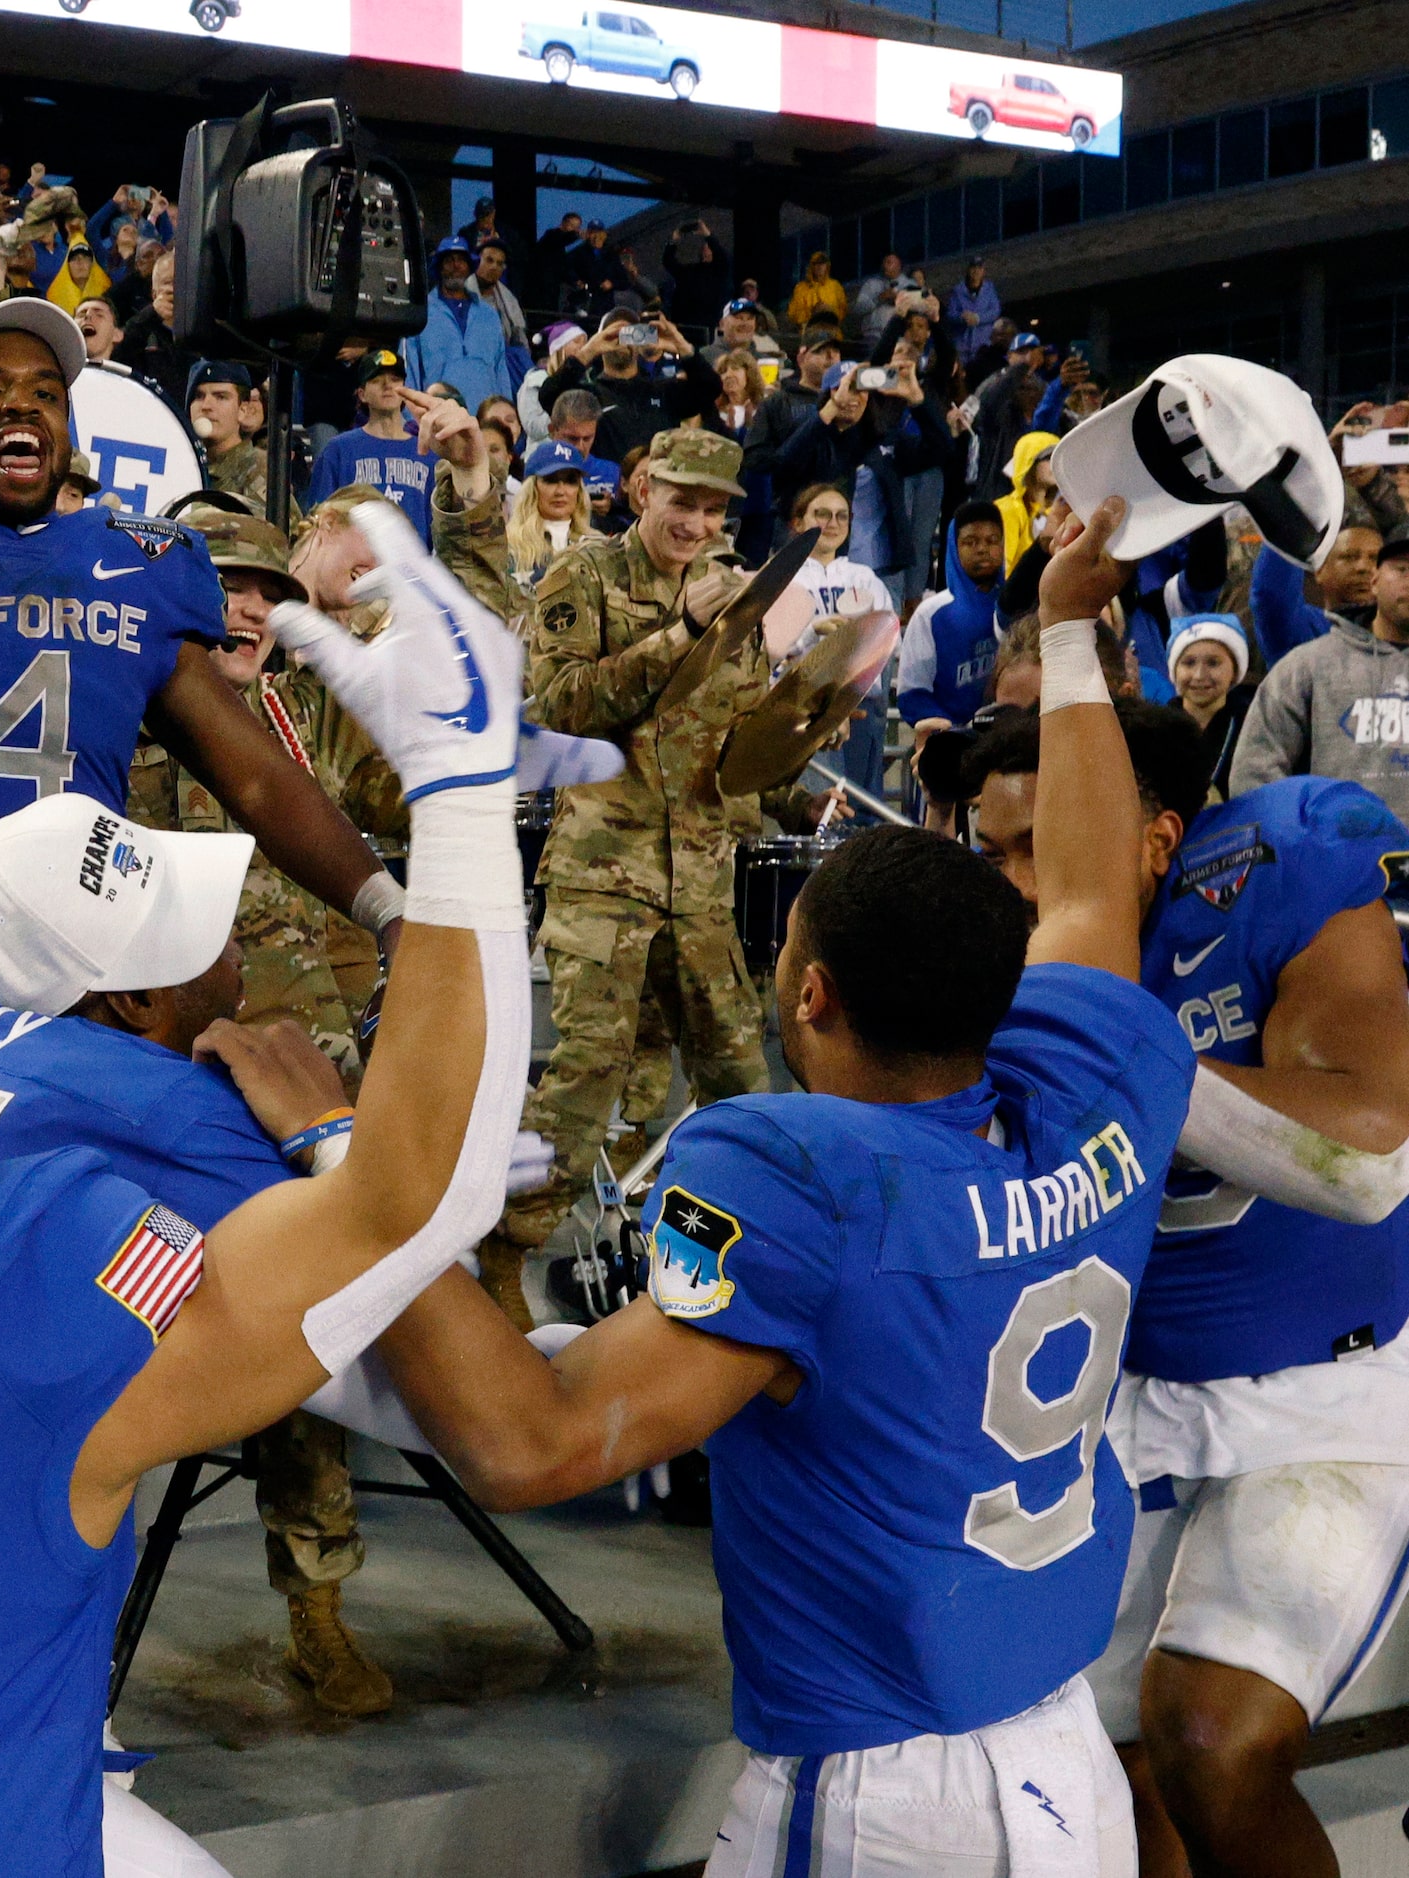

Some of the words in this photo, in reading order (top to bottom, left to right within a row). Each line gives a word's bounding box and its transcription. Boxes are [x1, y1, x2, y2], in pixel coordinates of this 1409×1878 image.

[354, 457, 383, 485] AIR
[80, 815, 120, 896] CHAMPS
[106, 888, 118, 903] 20
[603, 1185, 618, 1199] M
[966, 1120, 1147, 1260] LARRIER
[1349, 1333, 1360, 1348] L
[964, 1254, 1132, 1571] 9
